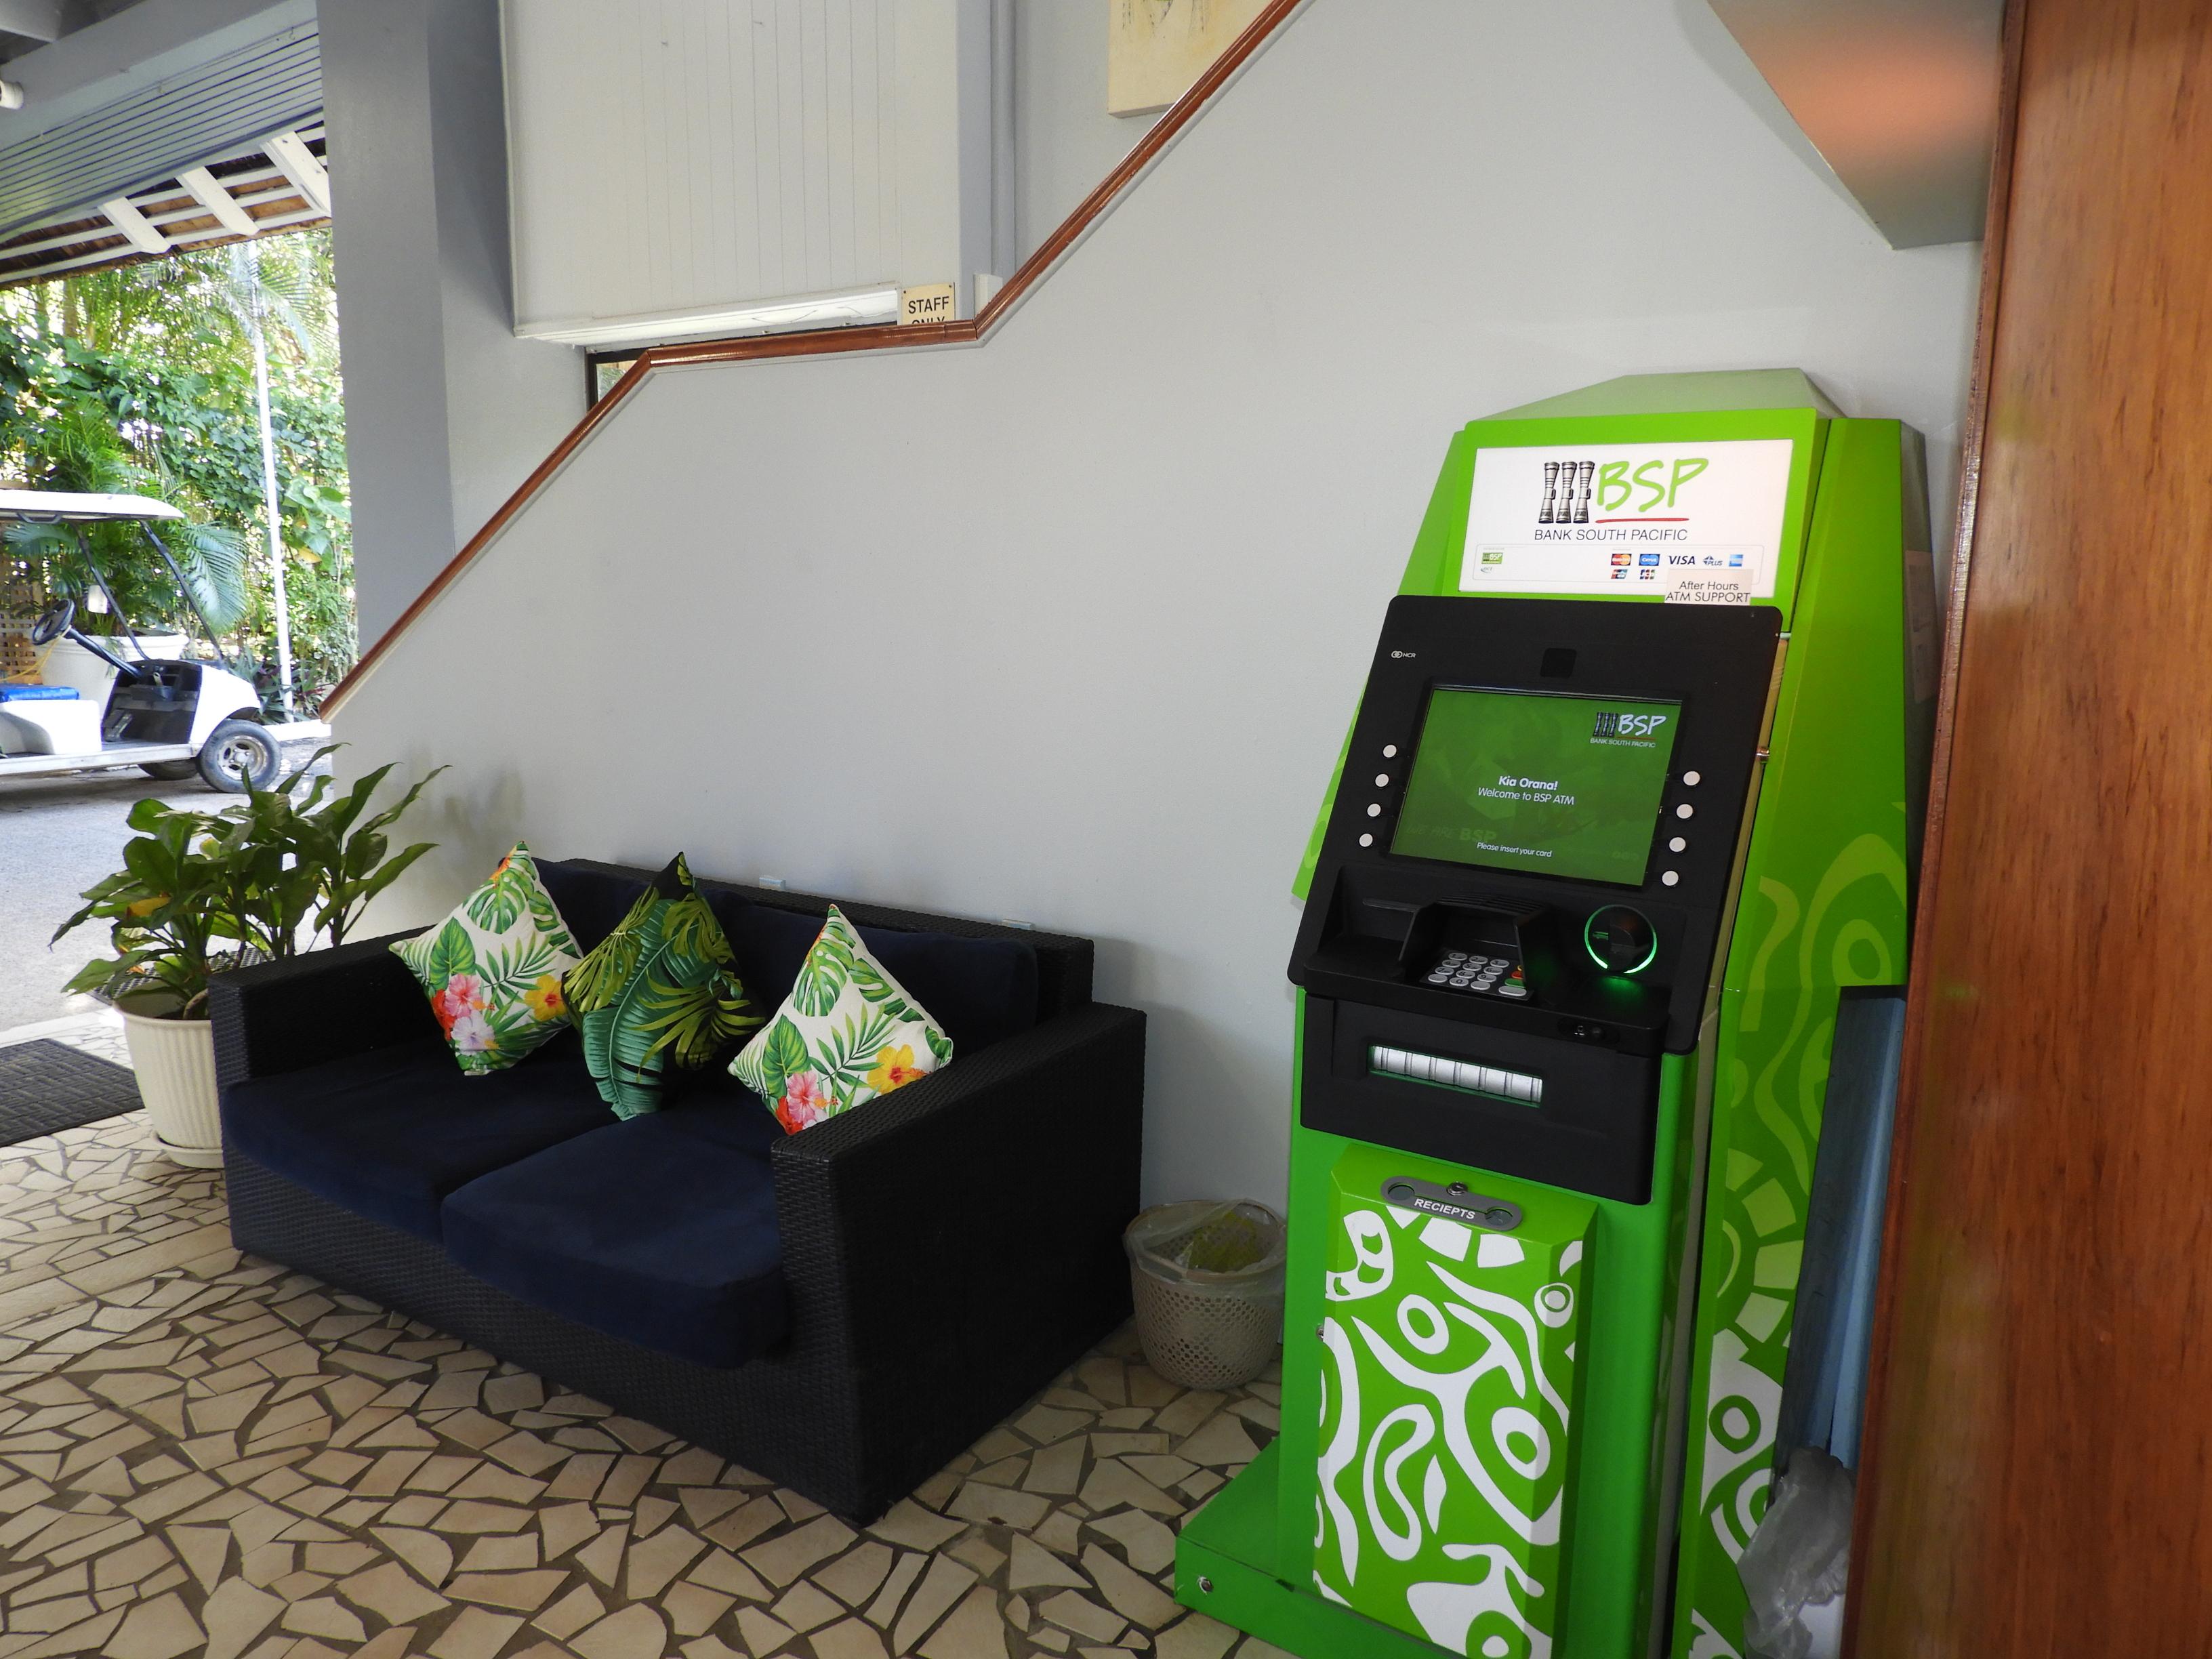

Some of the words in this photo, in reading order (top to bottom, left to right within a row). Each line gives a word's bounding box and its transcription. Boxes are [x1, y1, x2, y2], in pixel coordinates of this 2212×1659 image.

[908, 295, 949, 314] STAFF
[1597, 457, 1709, 513] BSP
[1534, 529, 1573, 541] BANK
[1576, 529, 1626, 541] SOUTH
[1631, 529, 1688, 541] PACIFIC
[1668, 555, 1696, 565] VISA
[1679, 581, 1704, 590] After
[1707, 581, 1739, 590] Hours
[1665, 592, 1691, 601] ATM
[1694, 592, 1751, 602] SUPPORT
[1618, 714, 1667, 736] BSP
[1498, 775, 1517, 787] Kia
[1519, 777, 1558, 791] Orana!
[1478, 787, 1521, 800] Welcome
[1523, 792, 1532, 800] to
[1533, 792, 1552, 802] BSP
[1553, 794, 1576, 805] ATM
[1459, 827, 1497, 841] BSP
[1477, 842, 1500, 851] Please
[1500, 845, 1519, 854] insert
[1519, 848, 1536, 857] your
[1536, 849, 1553, 858] card
[1414, 1198, 1475, 1220] RECIEPTS
